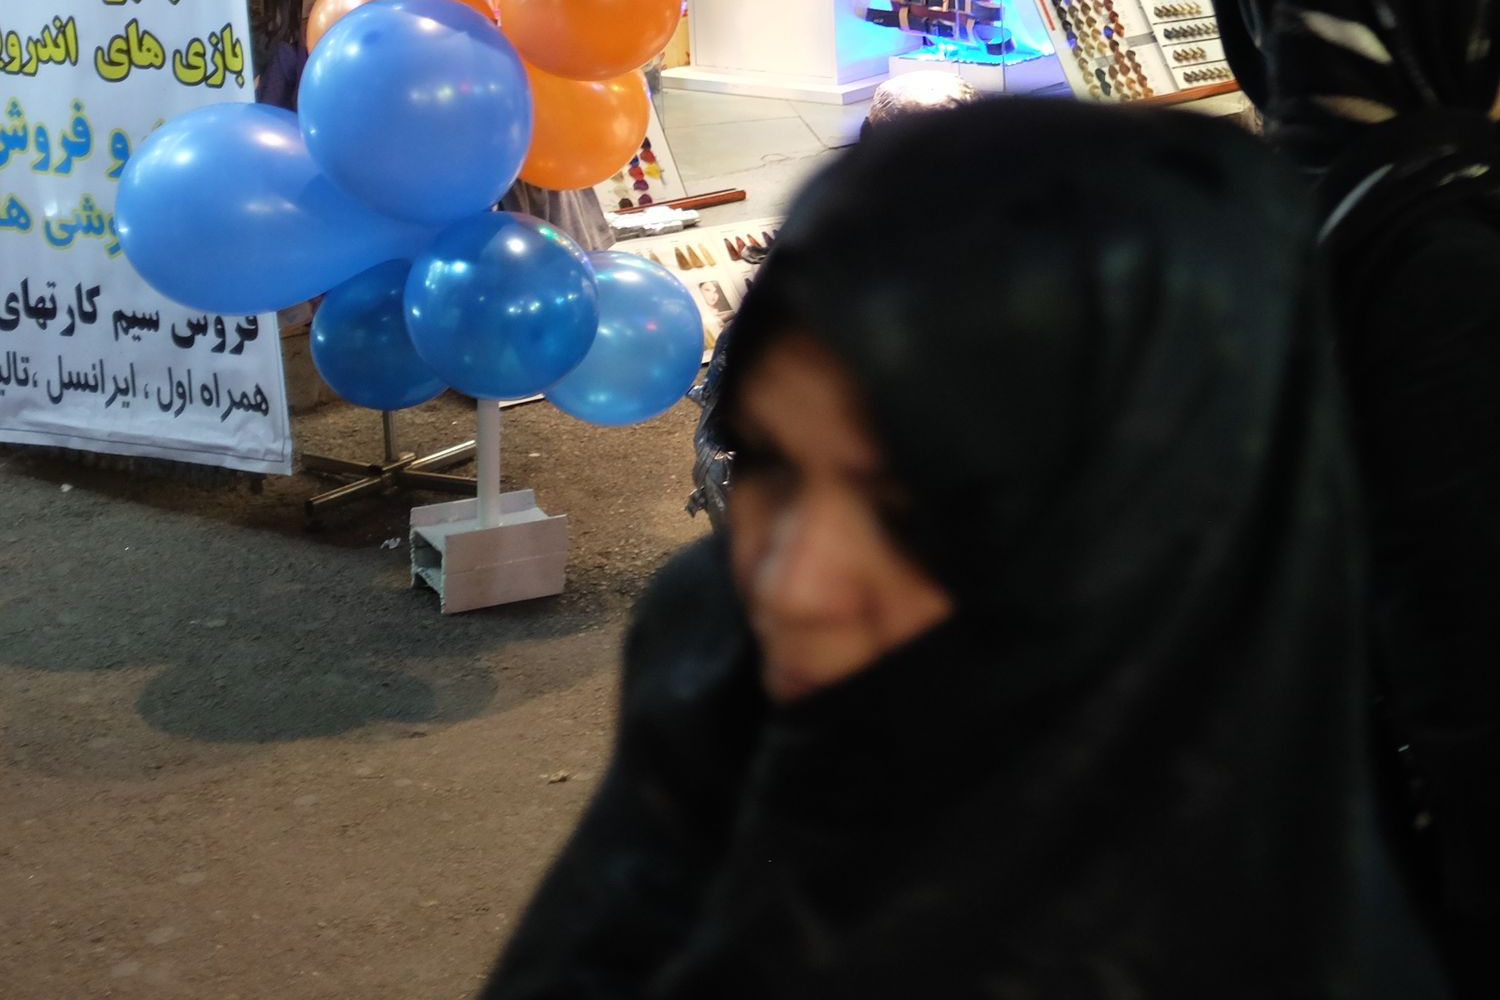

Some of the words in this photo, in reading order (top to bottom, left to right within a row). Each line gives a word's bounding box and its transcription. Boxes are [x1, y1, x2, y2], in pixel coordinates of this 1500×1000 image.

[94, 17, 166, 82] های
[172, 22, 245, 90] بازی
[112, 306, 161, 342] سیم
[46, 354, 137, 409] ایرانسل
[199, 371, 271, 424] همراه
